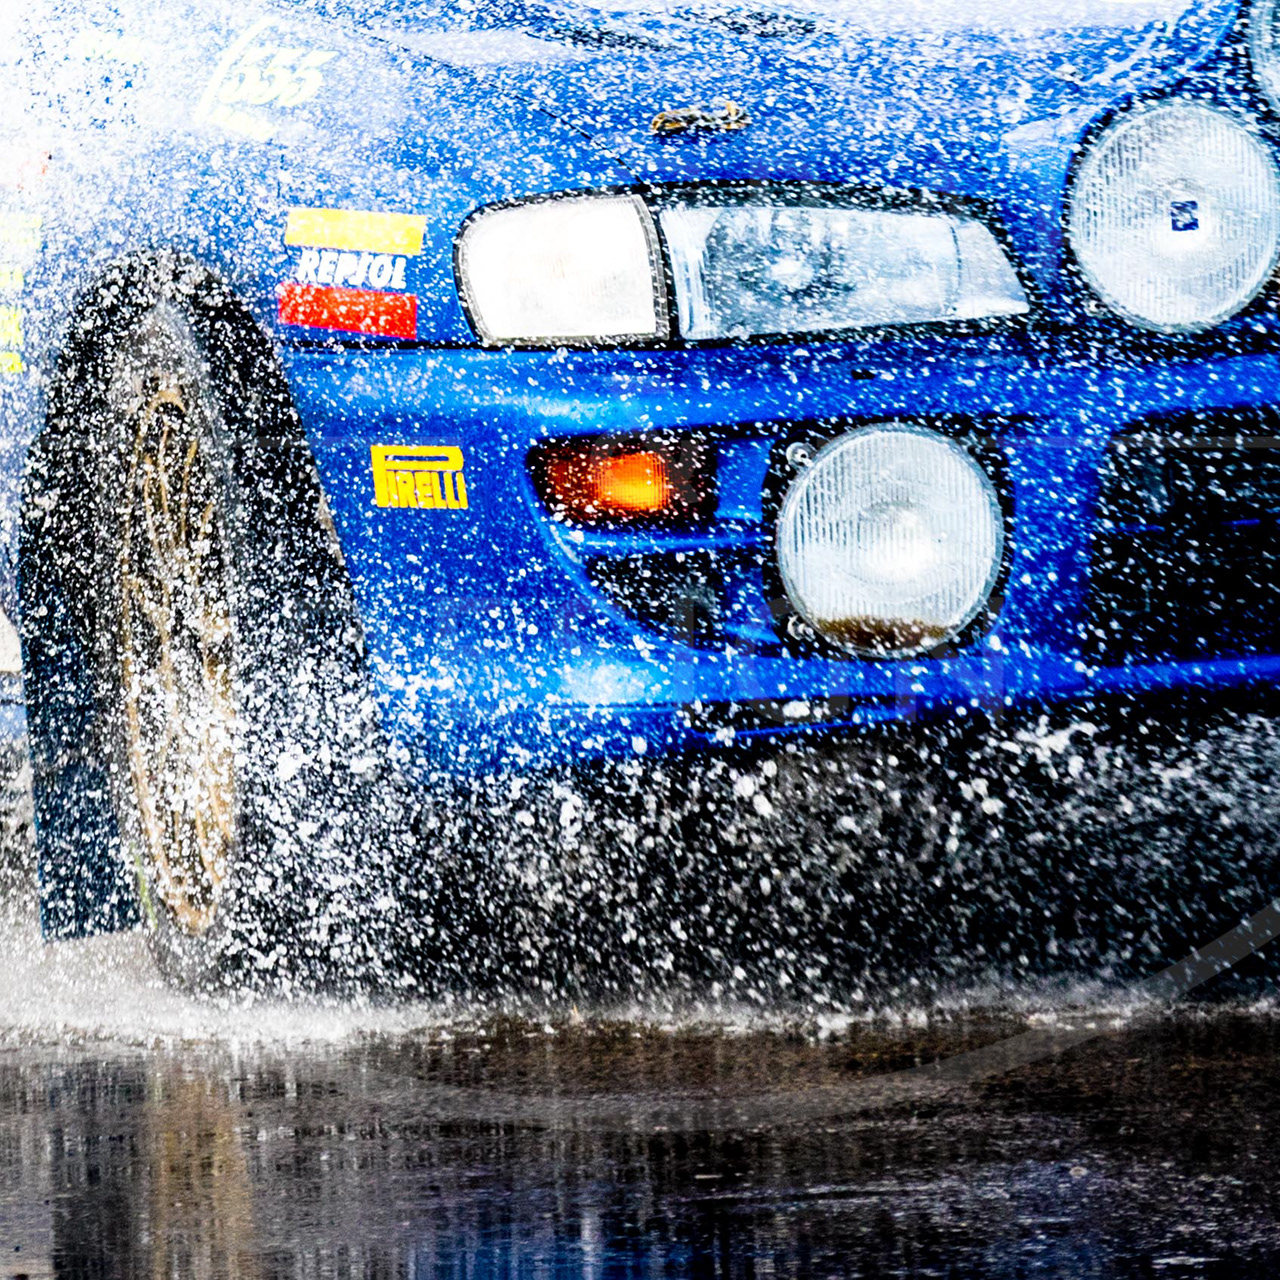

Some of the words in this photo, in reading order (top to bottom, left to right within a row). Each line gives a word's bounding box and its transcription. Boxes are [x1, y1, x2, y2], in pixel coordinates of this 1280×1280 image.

[220, 48, 340, 108] 555
[296, 249, 408, 290] REPSOL
[370, 443, 469, 510] PIRELLI
